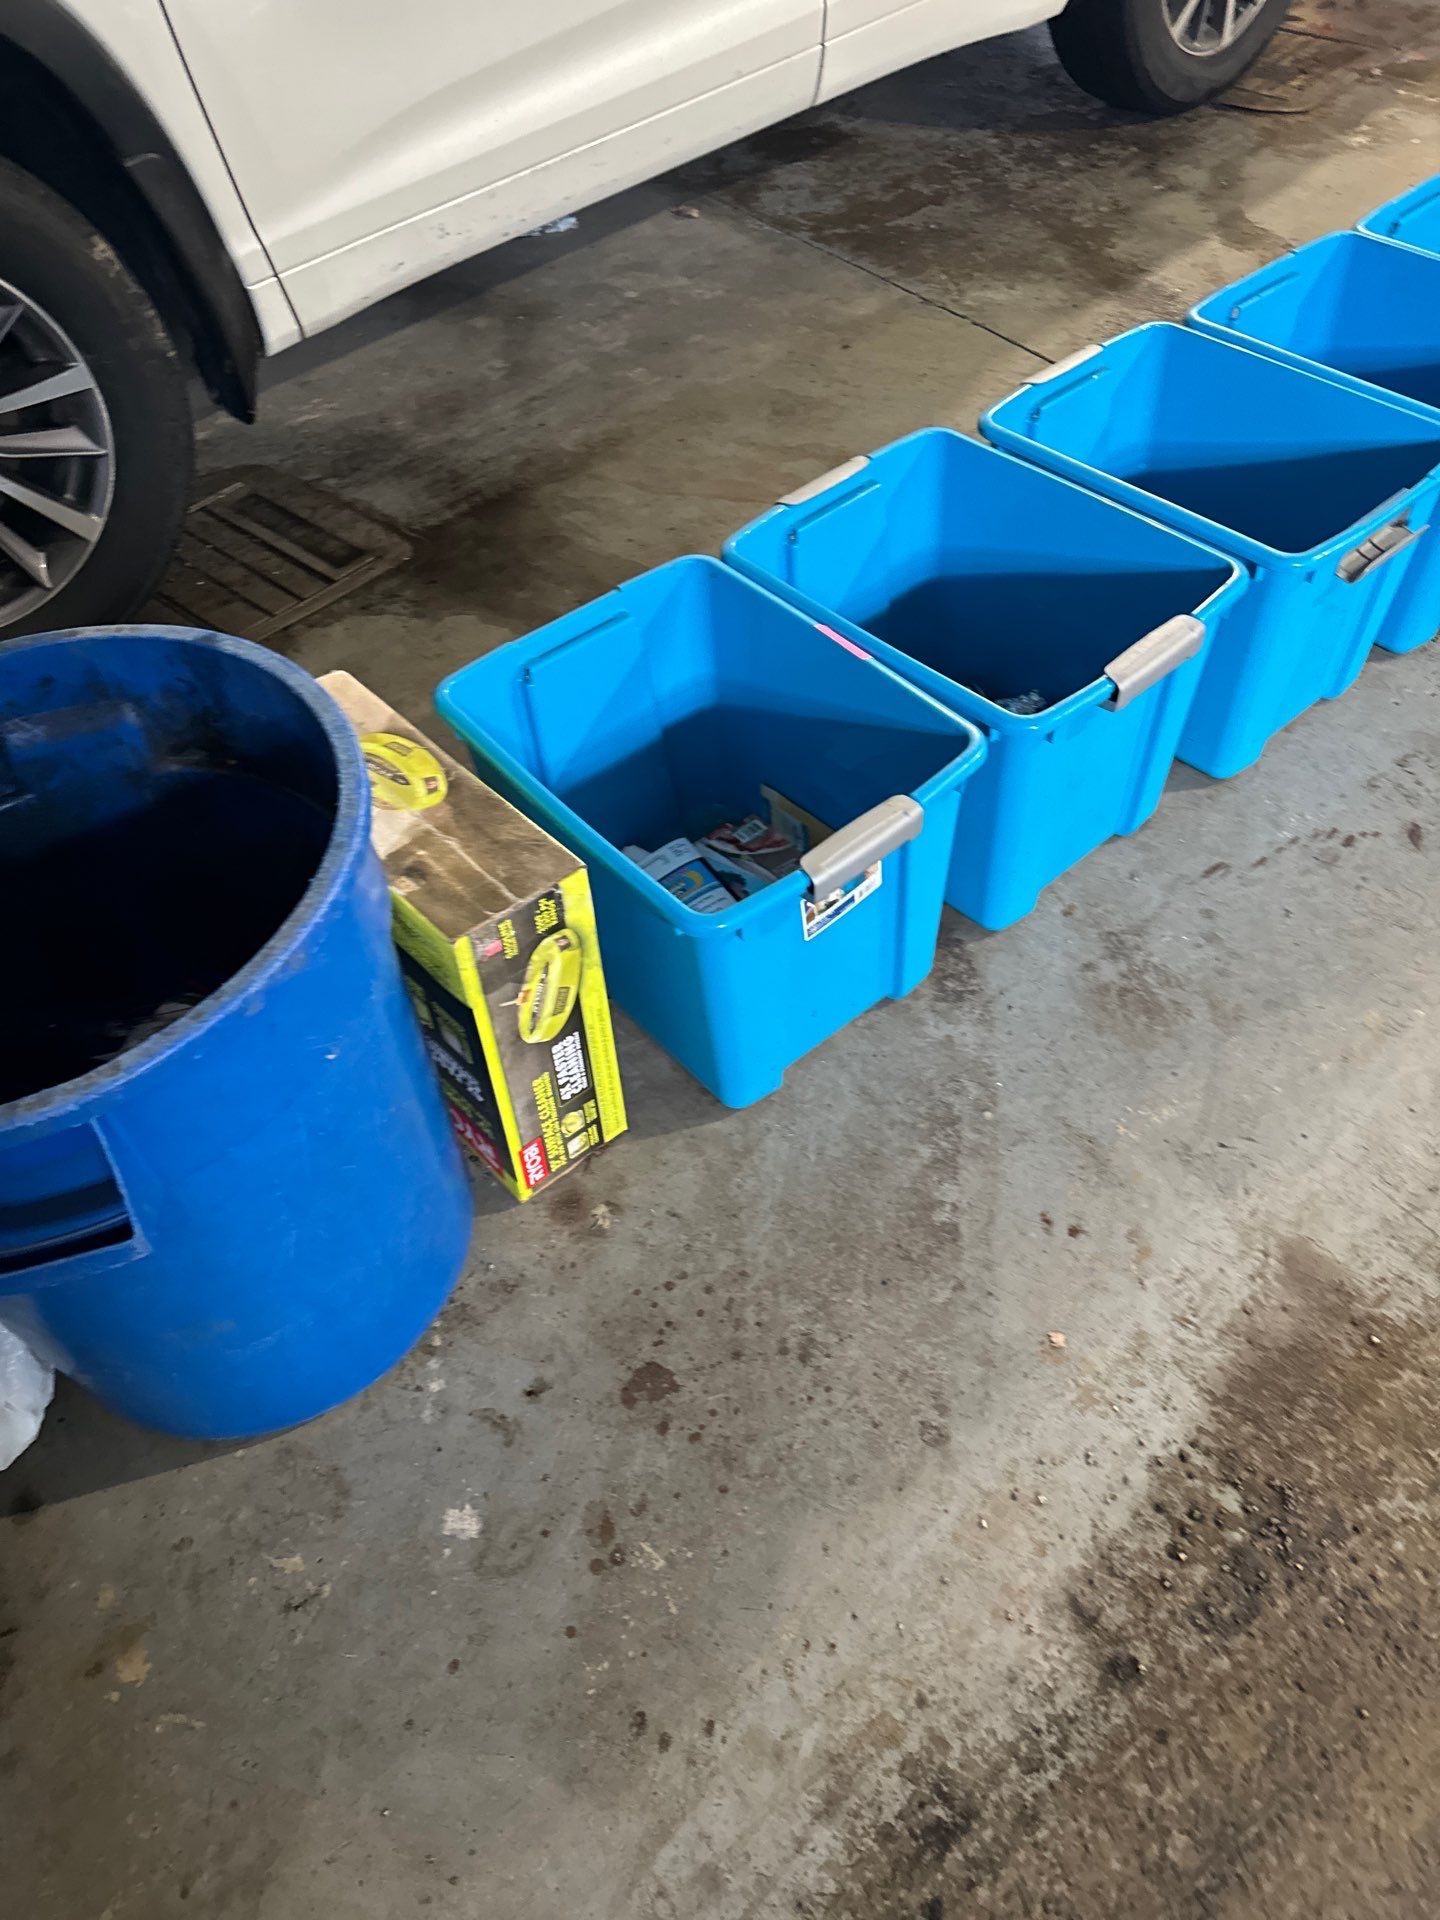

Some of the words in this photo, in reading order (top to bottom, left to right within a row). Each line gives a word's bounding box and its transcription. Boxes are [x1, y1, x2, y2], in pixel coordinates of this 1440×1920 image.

[551, 1042, 569, 1086] FASTER
[562, 1035, 583, 1094] CLEANING
[532, 1076, 551, 1121] CLEANER
[521, 1142, 545, 1185] RYOBI
